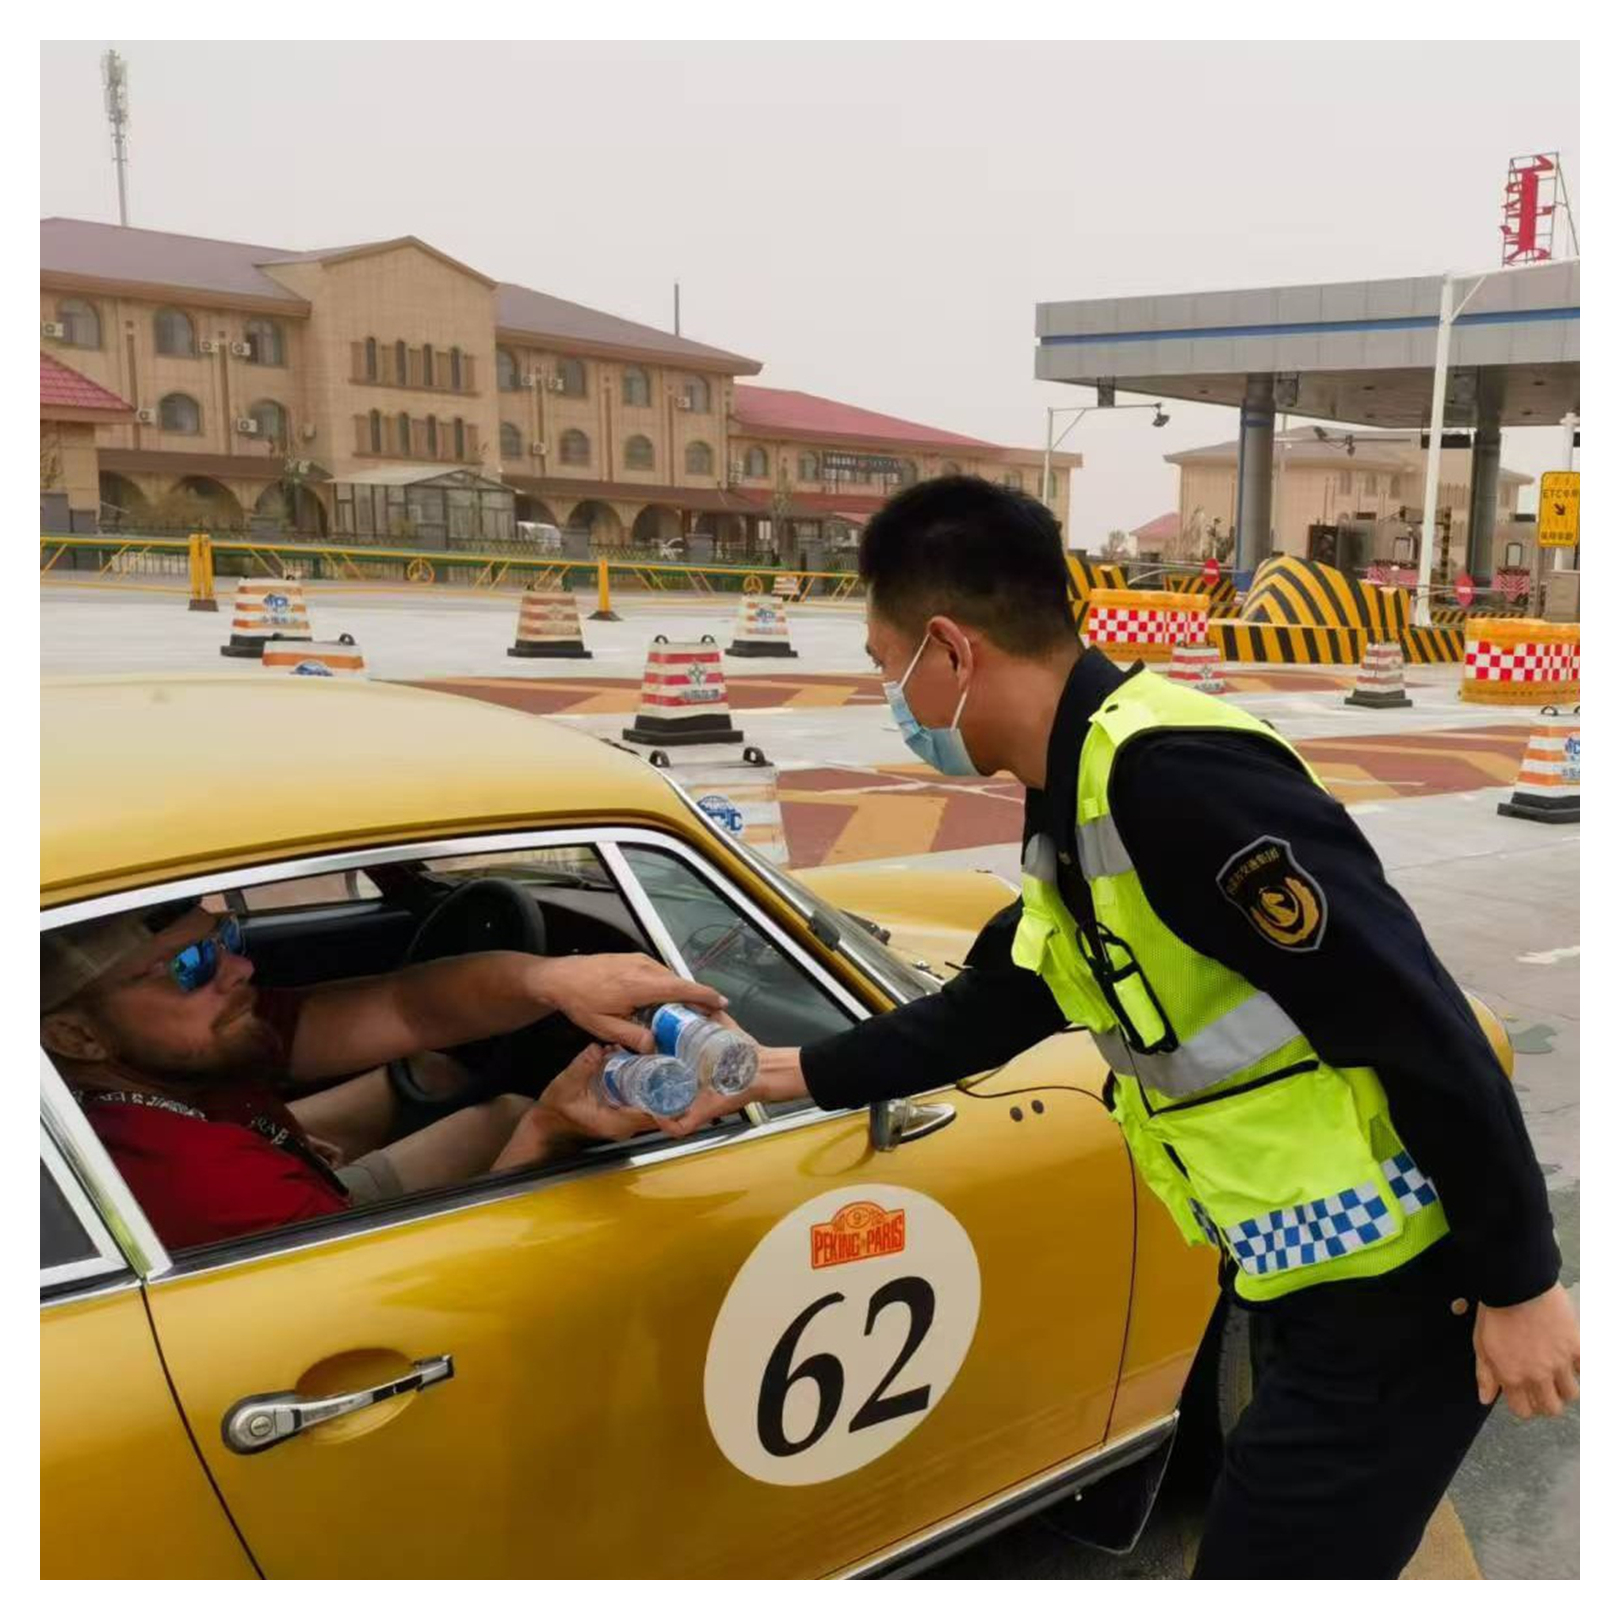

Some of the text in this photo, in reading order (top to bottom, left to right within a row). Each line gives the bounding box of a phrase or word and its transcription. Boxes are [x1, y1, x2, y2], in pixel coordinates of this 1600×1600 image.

[814, 1214, 904, 1265] PEKING PARIS
[757, 1276, 935, 1457] 62
